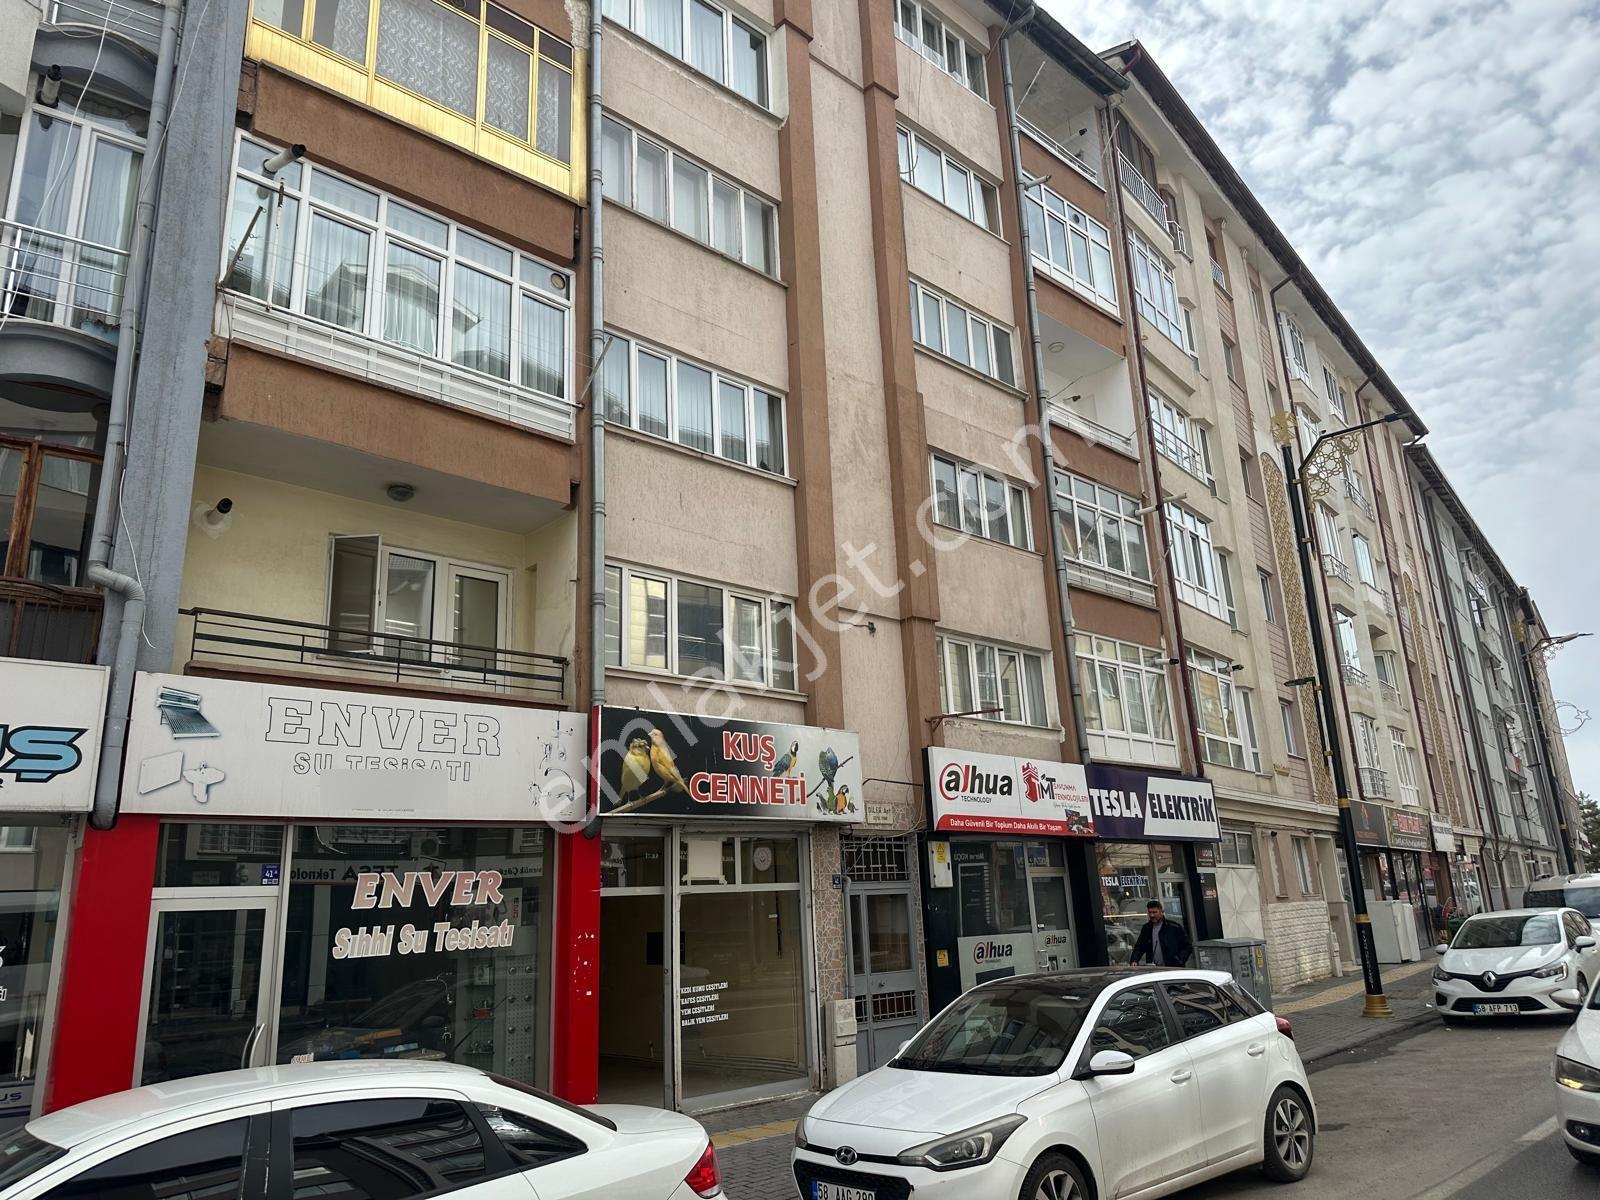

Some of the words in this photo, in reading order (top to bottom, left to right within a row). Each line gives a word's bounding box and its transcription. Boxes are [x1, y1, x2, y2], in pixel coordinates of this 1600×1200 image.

[265, 697, 500, 757] ENVER
[293, 752, 333, 775] SU
[723, 731, 776, 769] KUŞ
[689, 771, 807, 806] CENNETİ
[961, 795, 992, 804] TECHNOLOGY
[1089, 788, 1143, 819] TESLA
[1147, 793, 1216, 823] ELEKTRİK
[950, 818, 965, 827] Daha
[965, 818, 985, 828] Güvenli
[985, 820, 994, 828] Bir
[994, 820, 1013, 830] Toplum
[1013, 821, 1026, 830] Daha
[1039, 823, 1047, 831] Bir
[1047, 823, 1063, 832] Yaşam
[351, 870, 504, 910] ENVER
[1101, 876, 1119, 887] TESLA
[397, 923, 429, 955] Su
[1503, 1004, 1518, 1012] 713
[817, 1183, 829, 1200] 58
